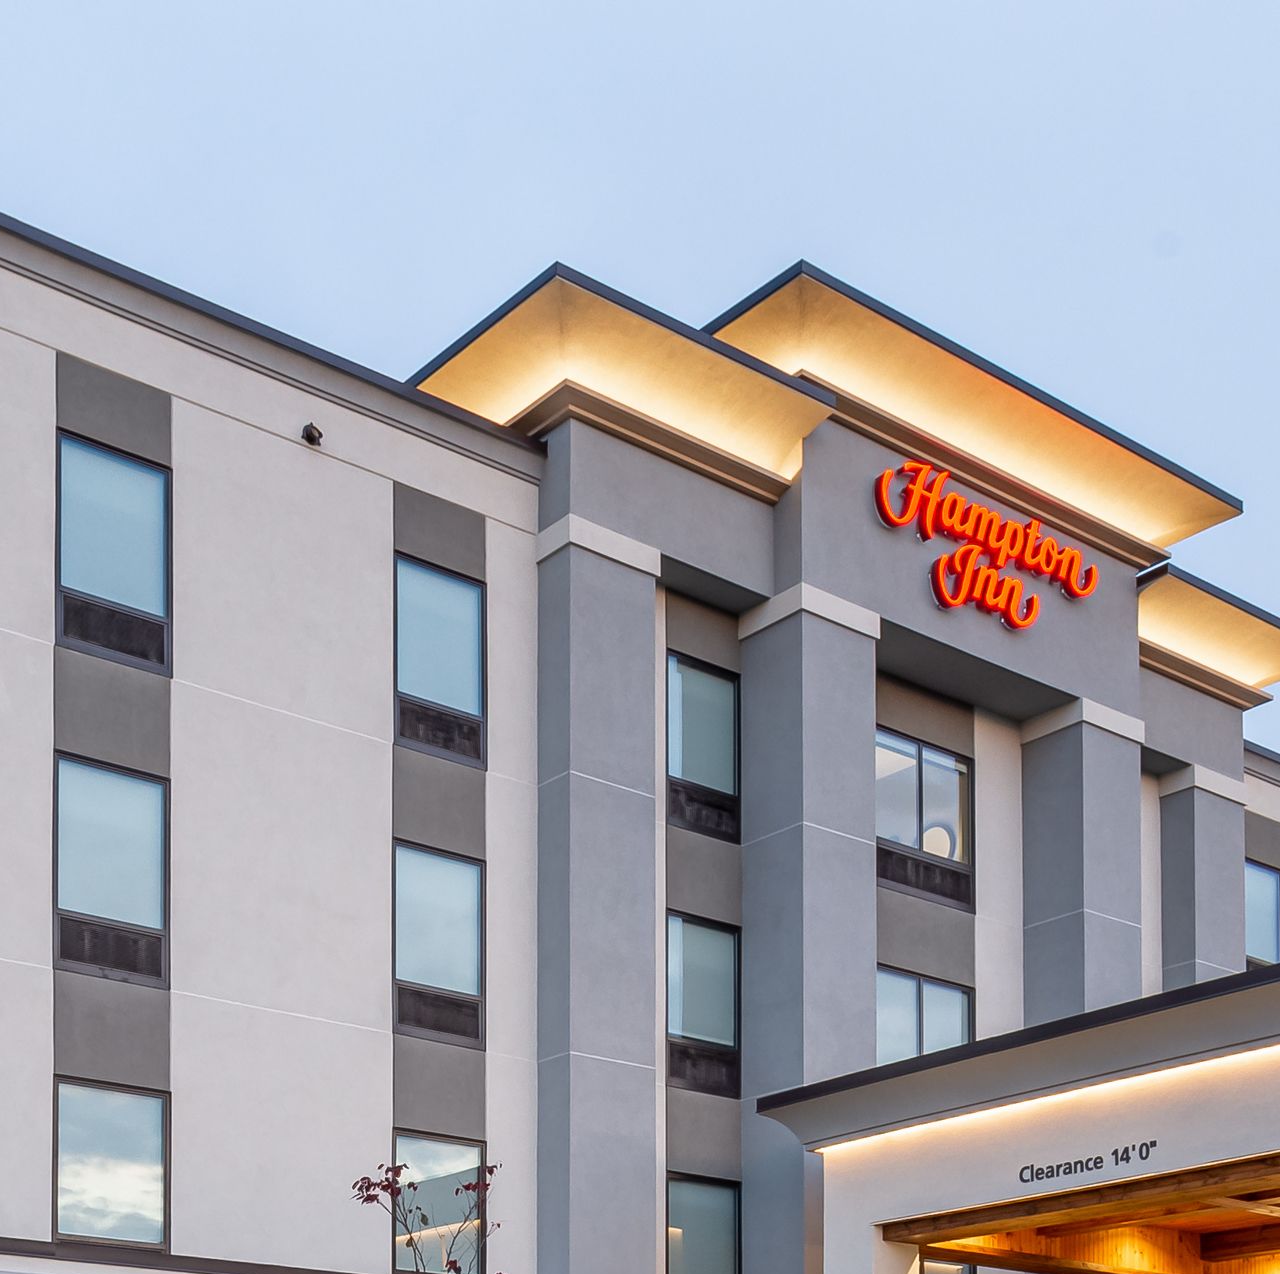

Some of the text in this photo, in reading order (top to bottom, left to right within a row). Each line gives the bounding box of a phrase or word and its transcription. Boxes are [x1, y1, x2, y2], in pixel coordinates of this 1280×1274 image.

[874, 459, 1099, 599] Hampton
[929, 544, 1040, 630] Inn
[1019, 1155, 1104, 1183] Clearance
